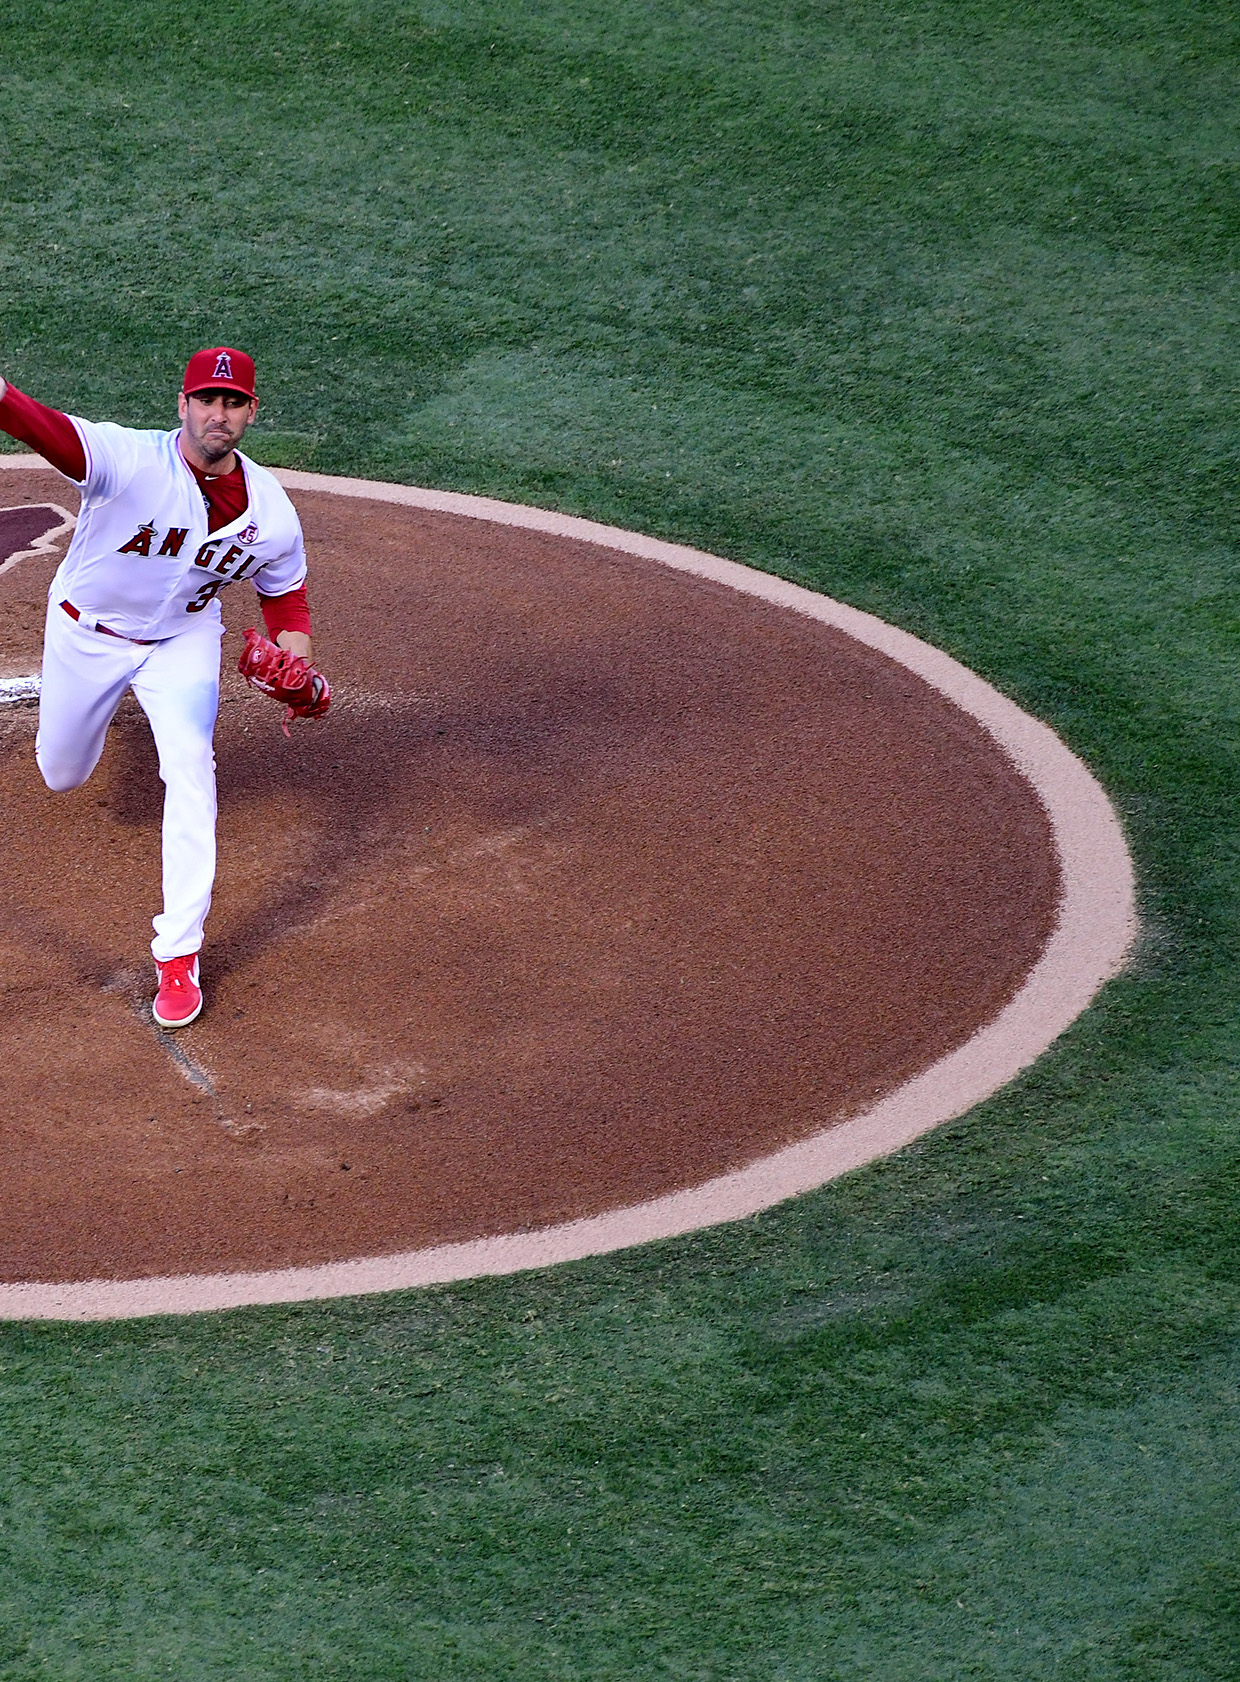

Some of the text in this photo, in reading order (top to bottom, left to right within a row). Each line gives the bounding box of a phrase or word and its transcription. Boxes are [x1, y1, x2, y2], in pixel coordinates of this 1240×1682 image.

[211, 352, 233, 379] A
[239, 529, 255, 542] 45
[186, 579, 232, 614] 3
